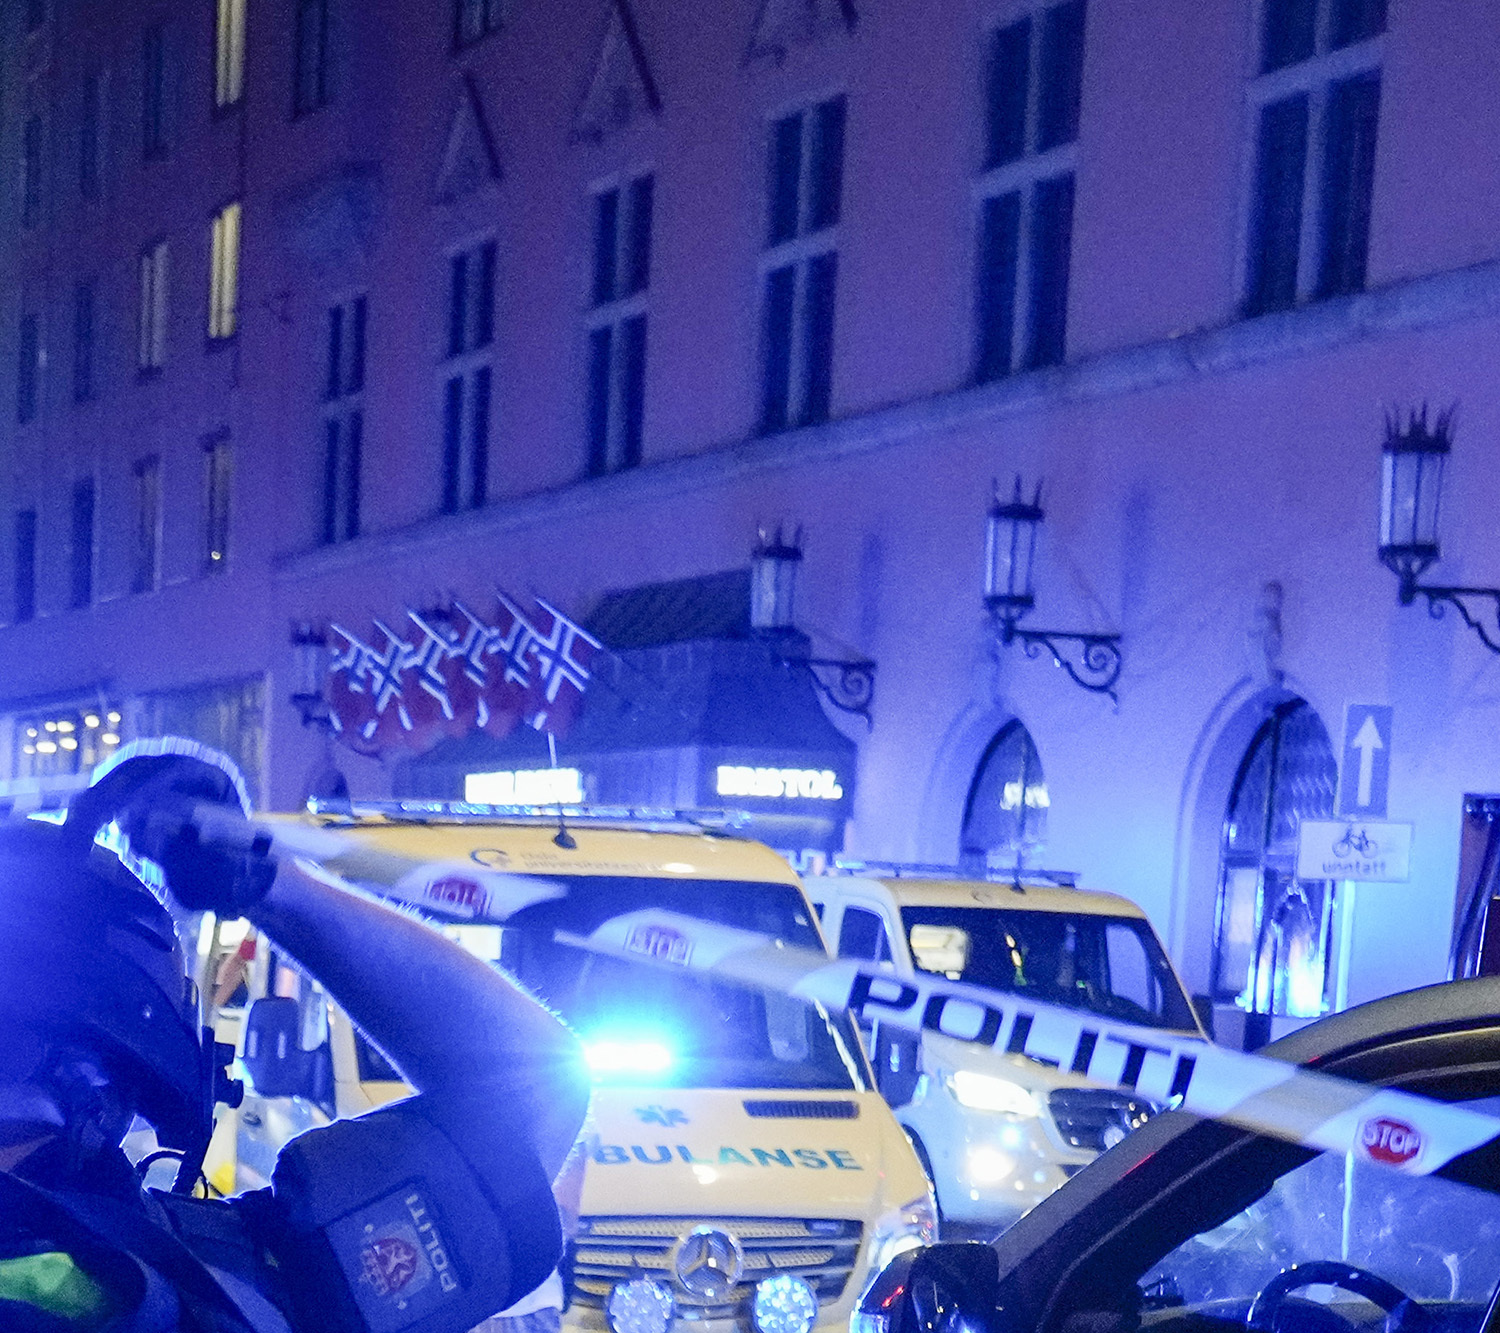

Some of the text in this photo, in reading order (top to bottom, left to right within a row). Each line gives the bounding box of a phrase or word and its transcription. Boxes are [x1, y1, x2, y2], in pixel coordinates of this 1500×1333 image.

[716, 765, 844, 800] BRISTOL
[846, 969, 1200, 1100] POLITI
[1362, 1119, 1421, 1156] STOP
[593, 1143, 865, 1171] BULANSE
[404, 1193, 459, 1293] POLITI
